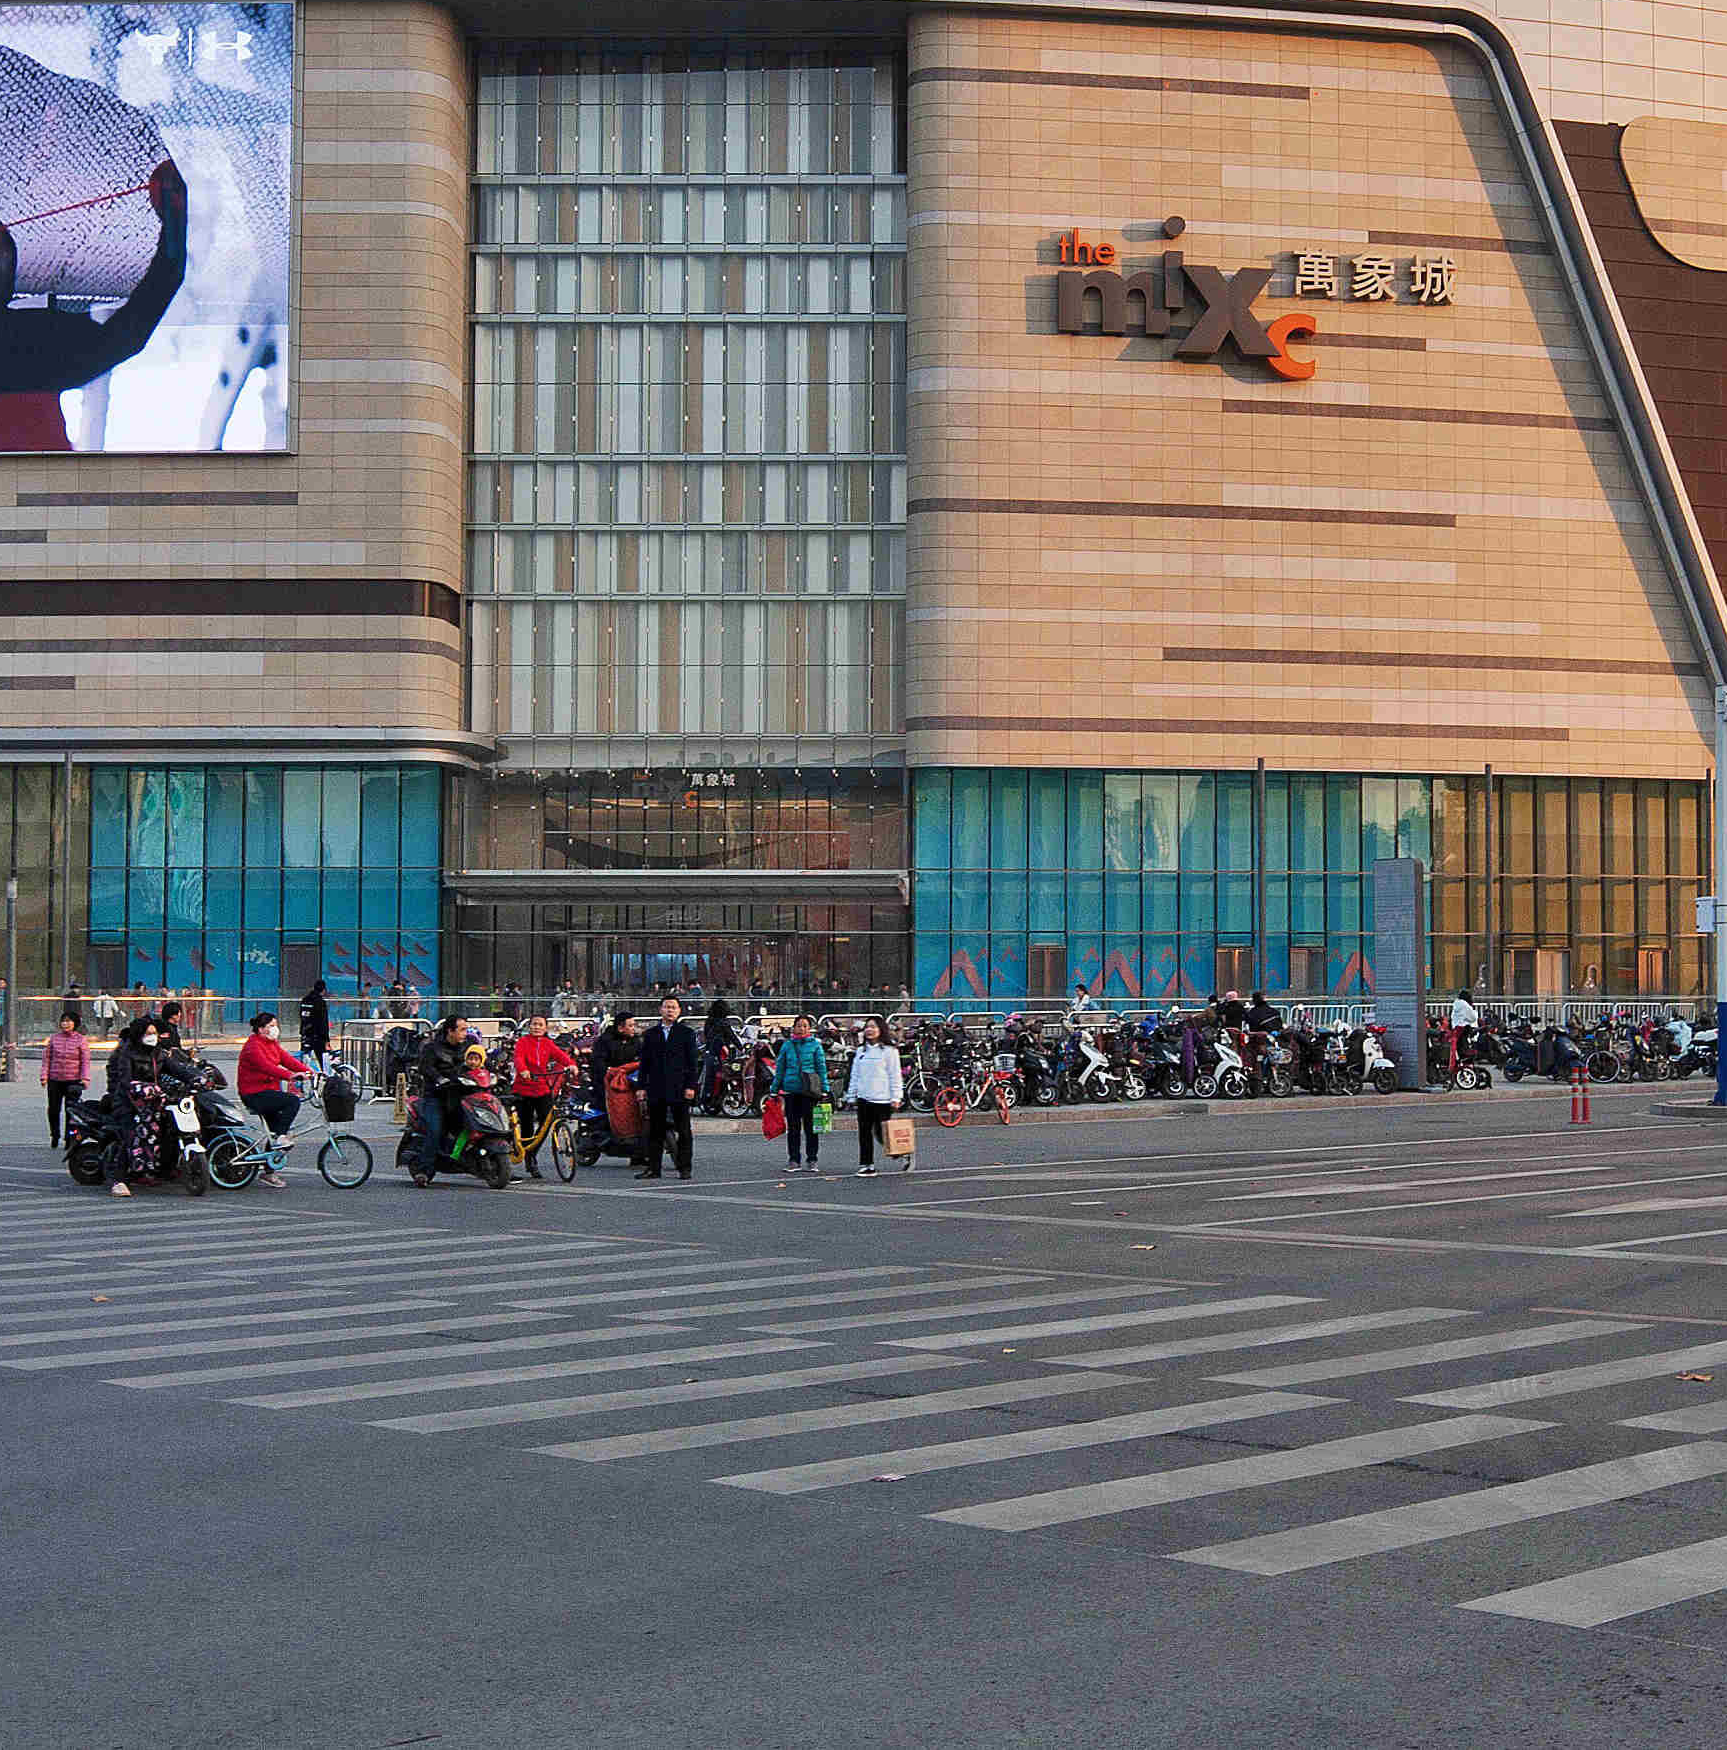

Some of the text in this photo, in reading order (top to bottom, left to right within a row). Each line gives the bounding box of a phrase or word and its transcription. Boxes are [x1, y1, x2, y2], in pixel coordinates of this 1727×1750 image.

[1058, 227, 1116, 266] the
[1292, 249, 1457, 306] 萬象城
